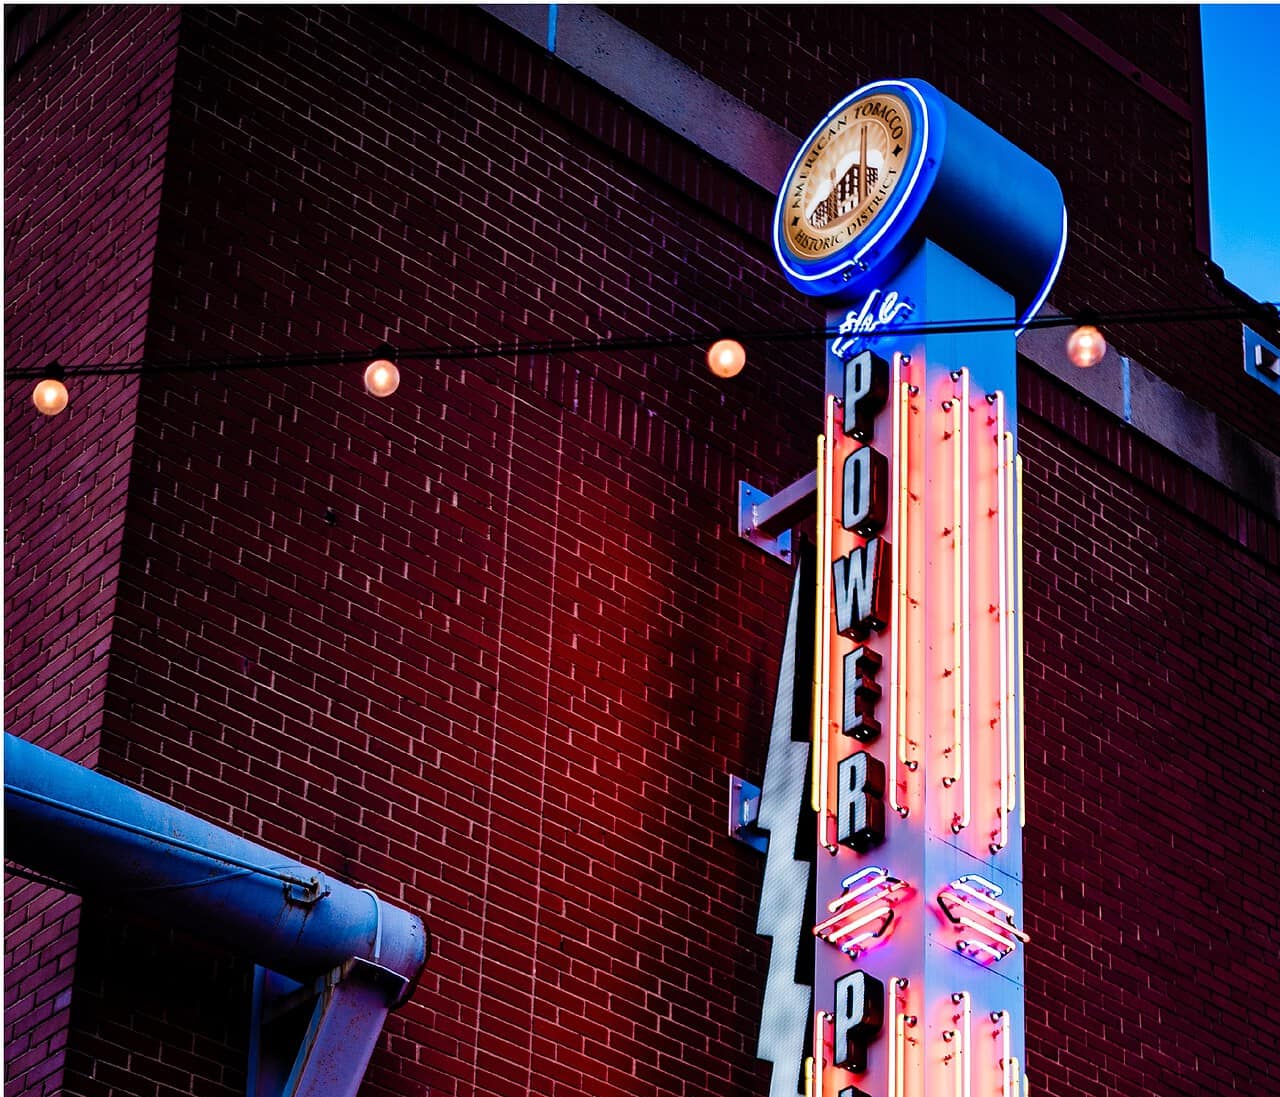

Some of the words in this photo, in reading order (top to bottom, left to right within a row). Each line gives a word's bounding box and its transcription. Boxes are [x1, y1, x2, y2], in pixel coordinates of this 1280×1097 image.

[792, 115, 849, 210] AMERICAN
[854, 102, 904, 141] TOBACCO
[794, 229, 845, 252] HISTORIC
[847, 168, 898, 236] DISTRICT
[832, 350, 890, 852] POWER
